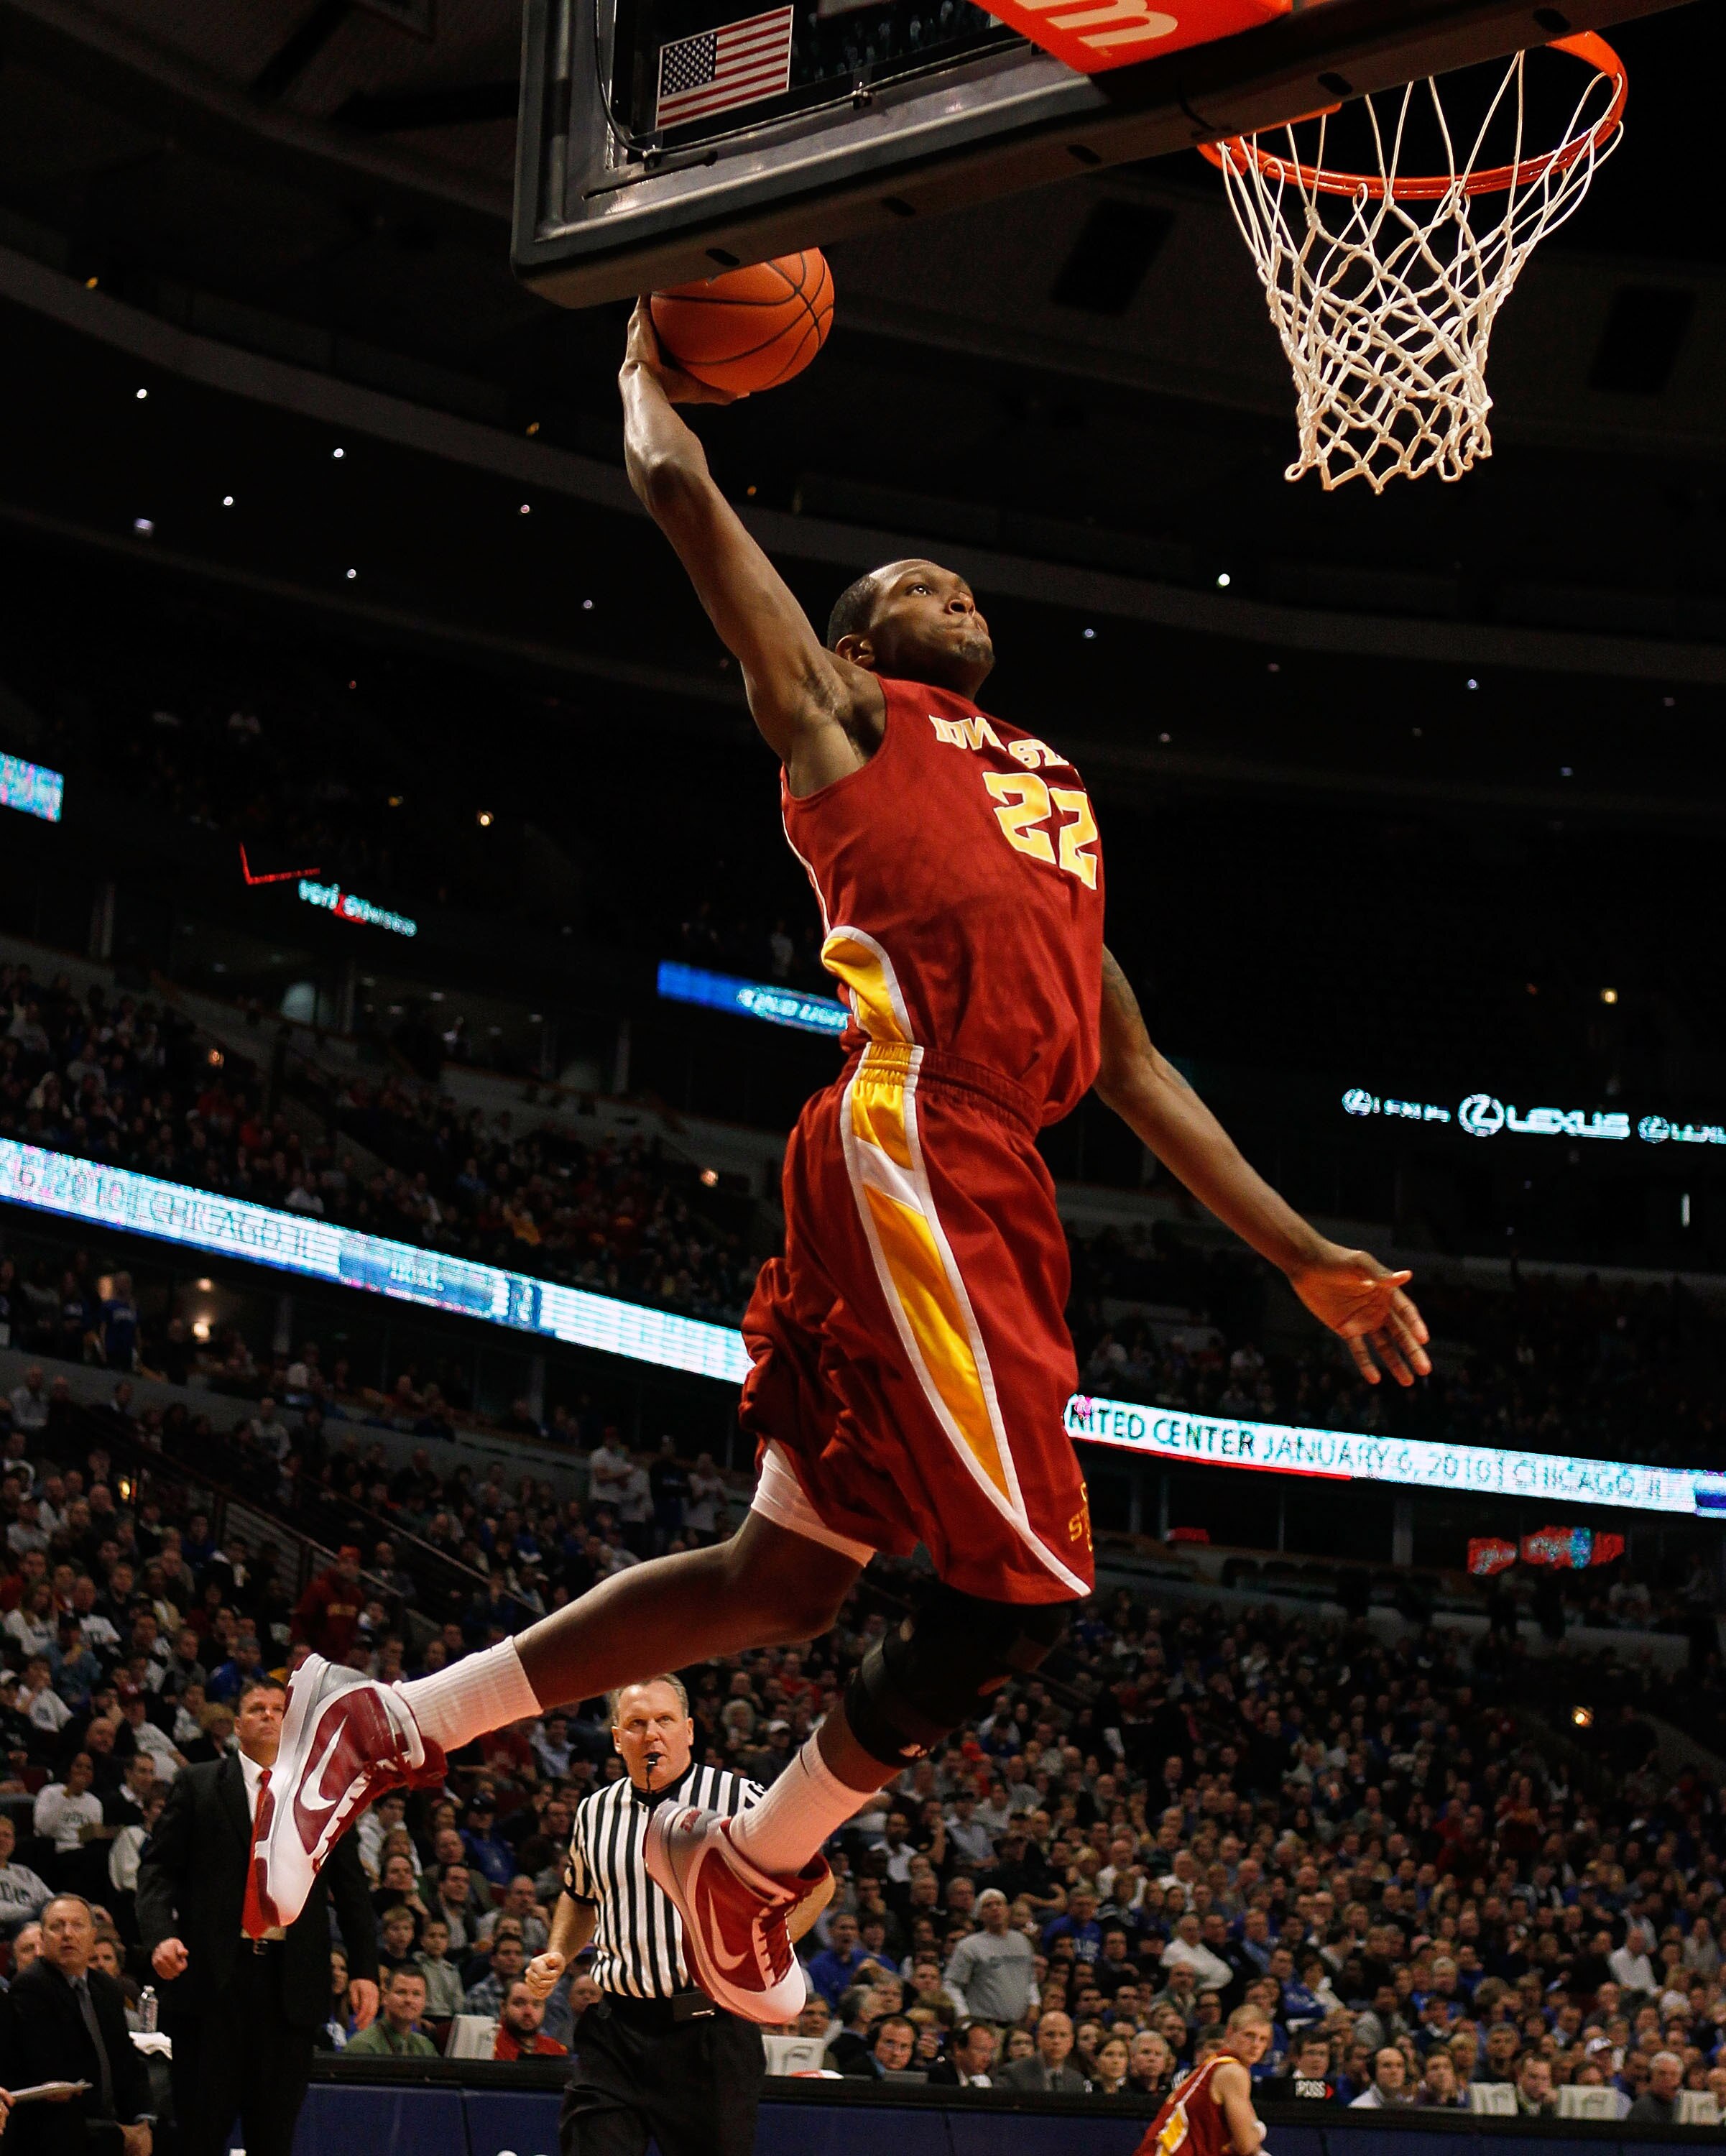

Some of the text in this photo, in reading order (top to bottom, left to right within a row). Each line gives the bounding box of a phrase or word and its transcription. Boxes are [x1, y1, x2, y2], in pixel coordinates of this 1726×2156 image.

[982, 771, 1099, 890] 22
[1505, 1105, 1630, 1140] LEXUS
[1069, 1403, 1145, 1440] NITED
[1153, 1418, 1255, 1457] CENTER
[1263, 1435, 1390, 1470] JANUARY
[1427, 1450, 1492, 1485] 2010
[1296, 2079, 1326, 2099] POSS
